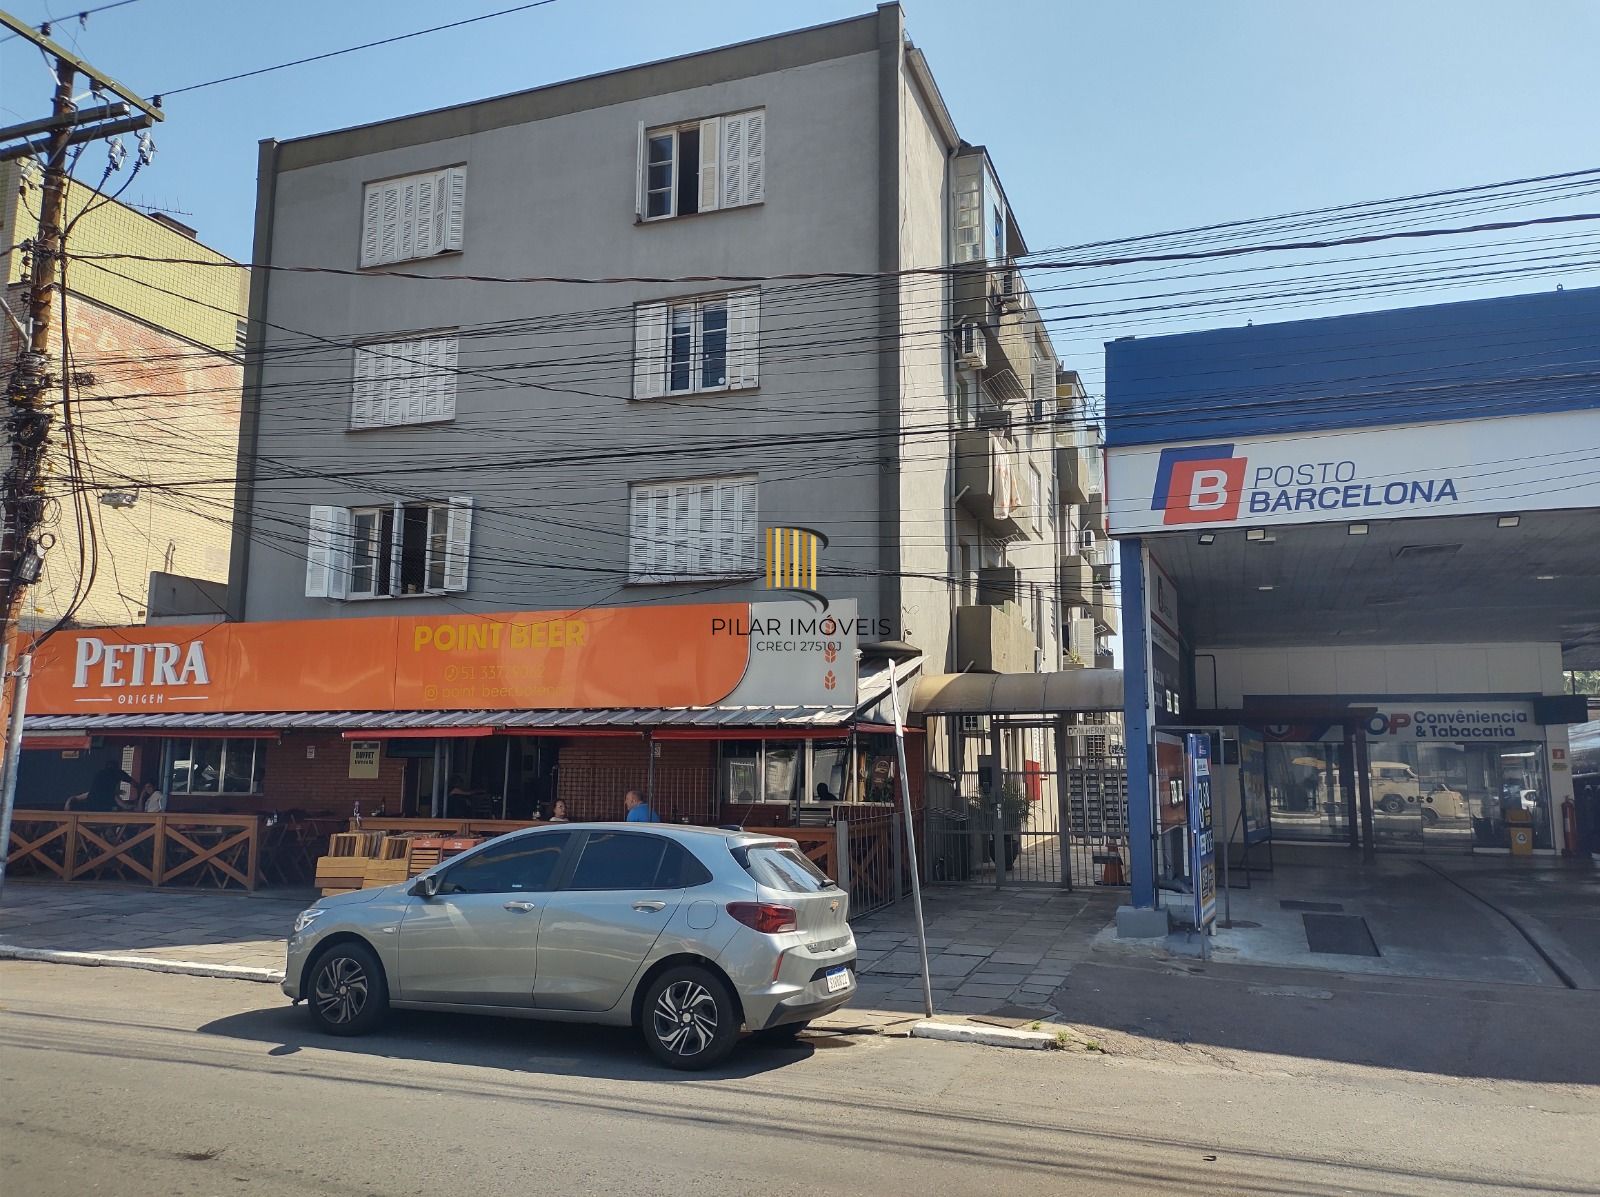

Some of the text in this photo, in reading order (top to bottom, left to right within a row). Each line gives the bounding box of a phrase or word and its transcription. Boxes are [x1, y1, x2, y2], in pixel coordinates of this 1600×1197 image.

[1254, 460, 1356, 488] POSTO
[1188, 468, 1229, 512] B
[1249, 478, 1459, 514] BARCELONA
[414, 620, 586, 651] POINT BEER
[72, 637, 210, 689] PETRA
[1413, 709, 1528, 724] Convêniencia
[1415, 725, 1516, 738] & Tabacaria
